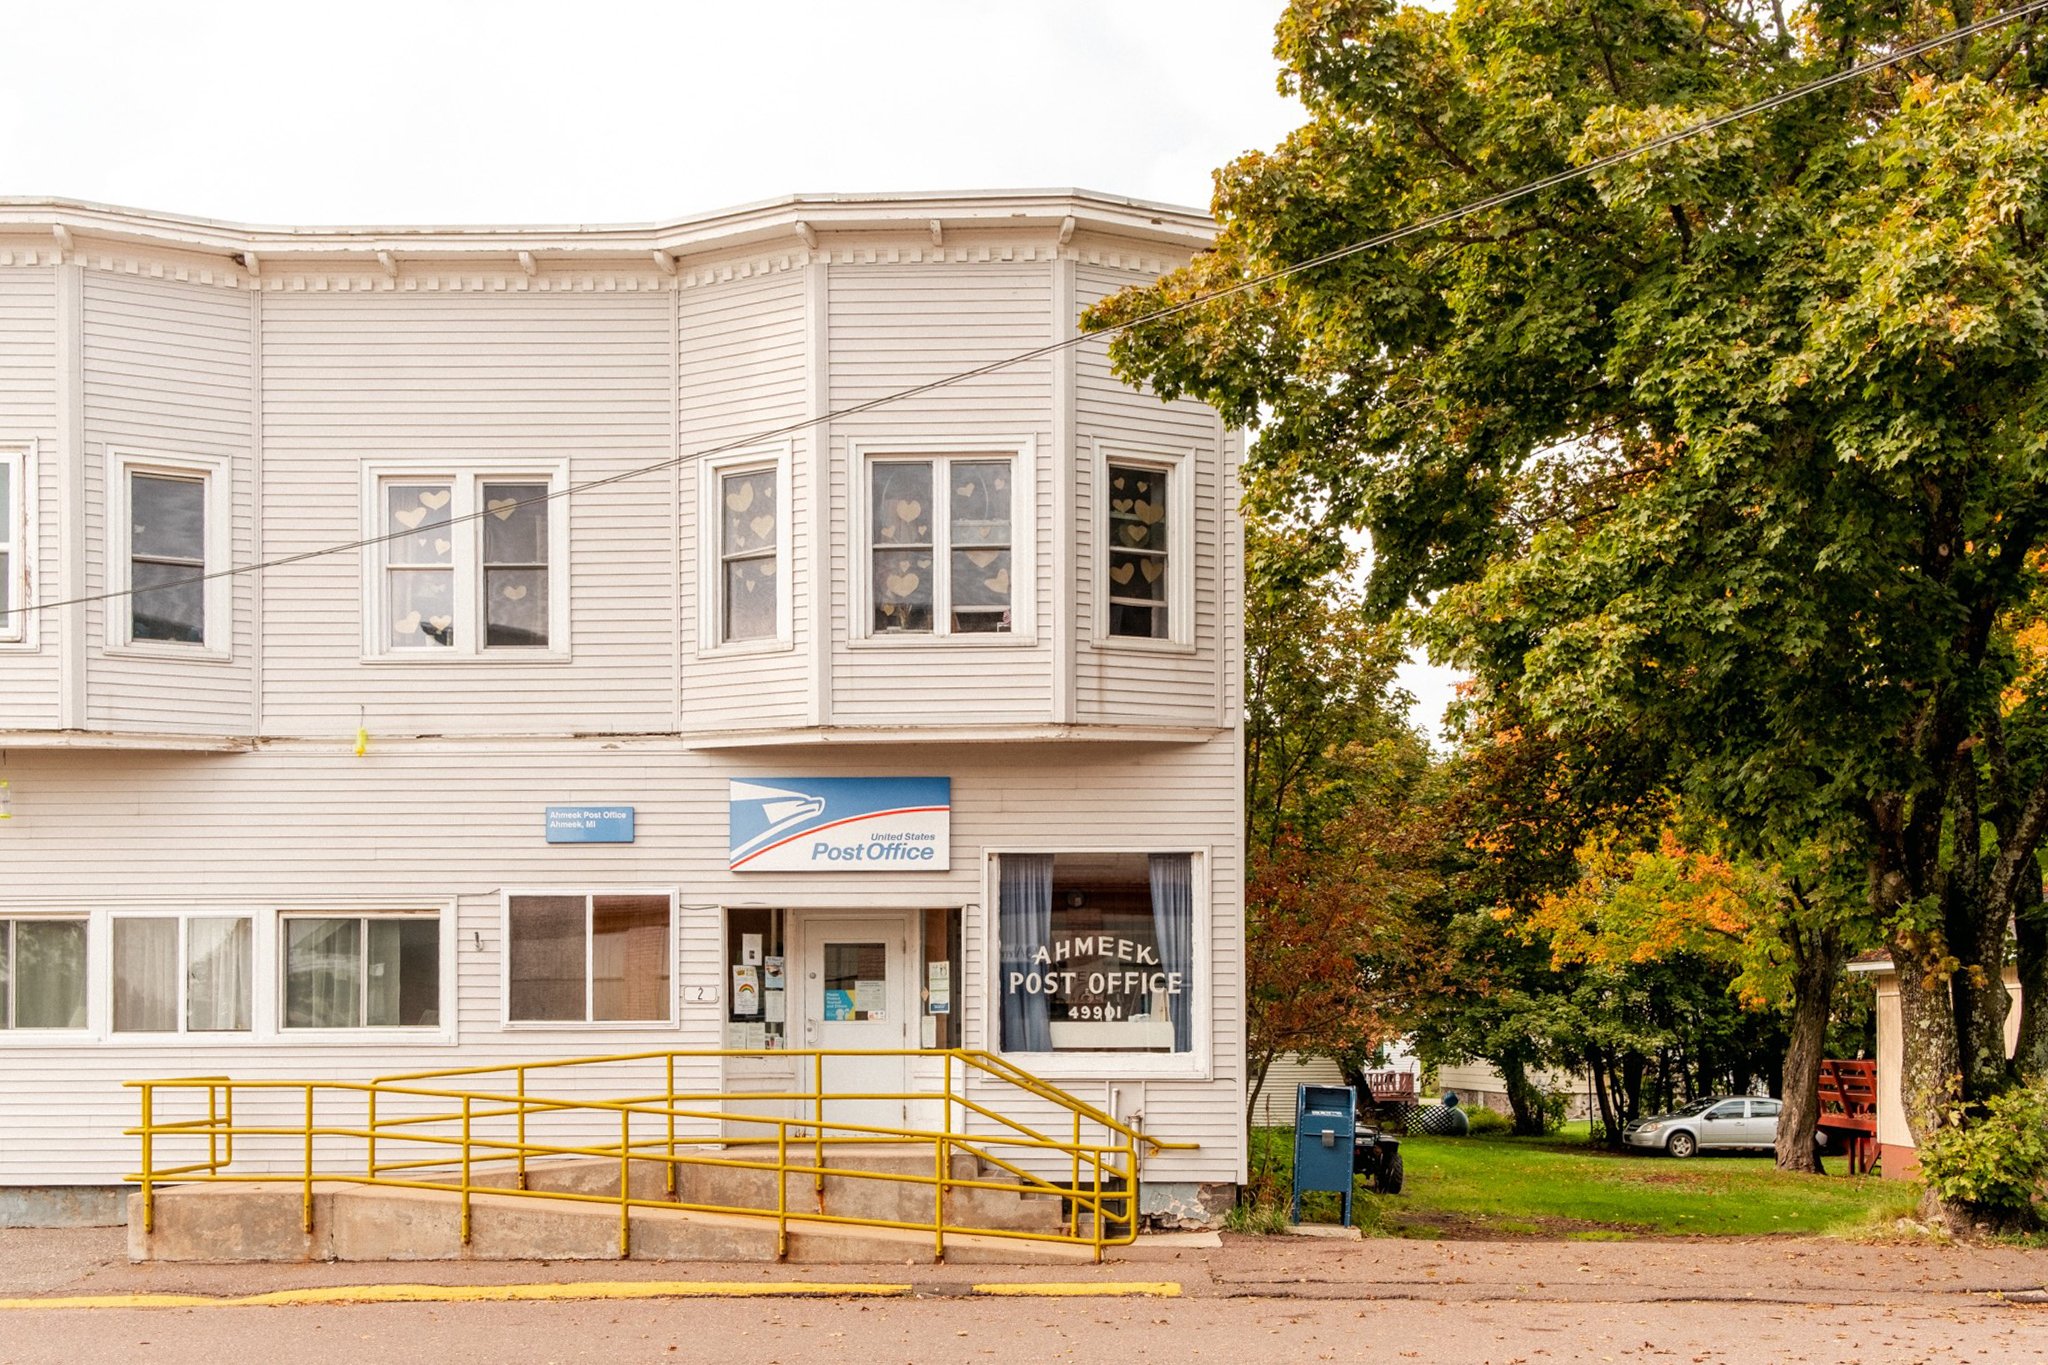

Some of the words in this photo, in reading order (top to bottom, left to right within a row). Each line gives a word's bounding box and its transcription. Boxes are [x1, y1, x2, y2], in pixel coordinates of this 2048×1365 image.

[550, 811, 582, 819] Ahmeek
[583, 811, 602, 819] Post
[603, 811, 627, 819] Office
[550, 821, 584, 829] Ahmeek,
[871, 833, 903, 841] United
[904, 833, 936, 841] States
[811, 842, 865, 861] Post
[866, 842, 935, 860] Office
[1031, 935, 1160, 966] AHMEEK
[1009, 972, 1077, 995] POST
[1088, 971, 1183, 995] OFFICE
[697, 986, 704, 1000] 2
[1068, 1005, 1121, 1019] 49901
